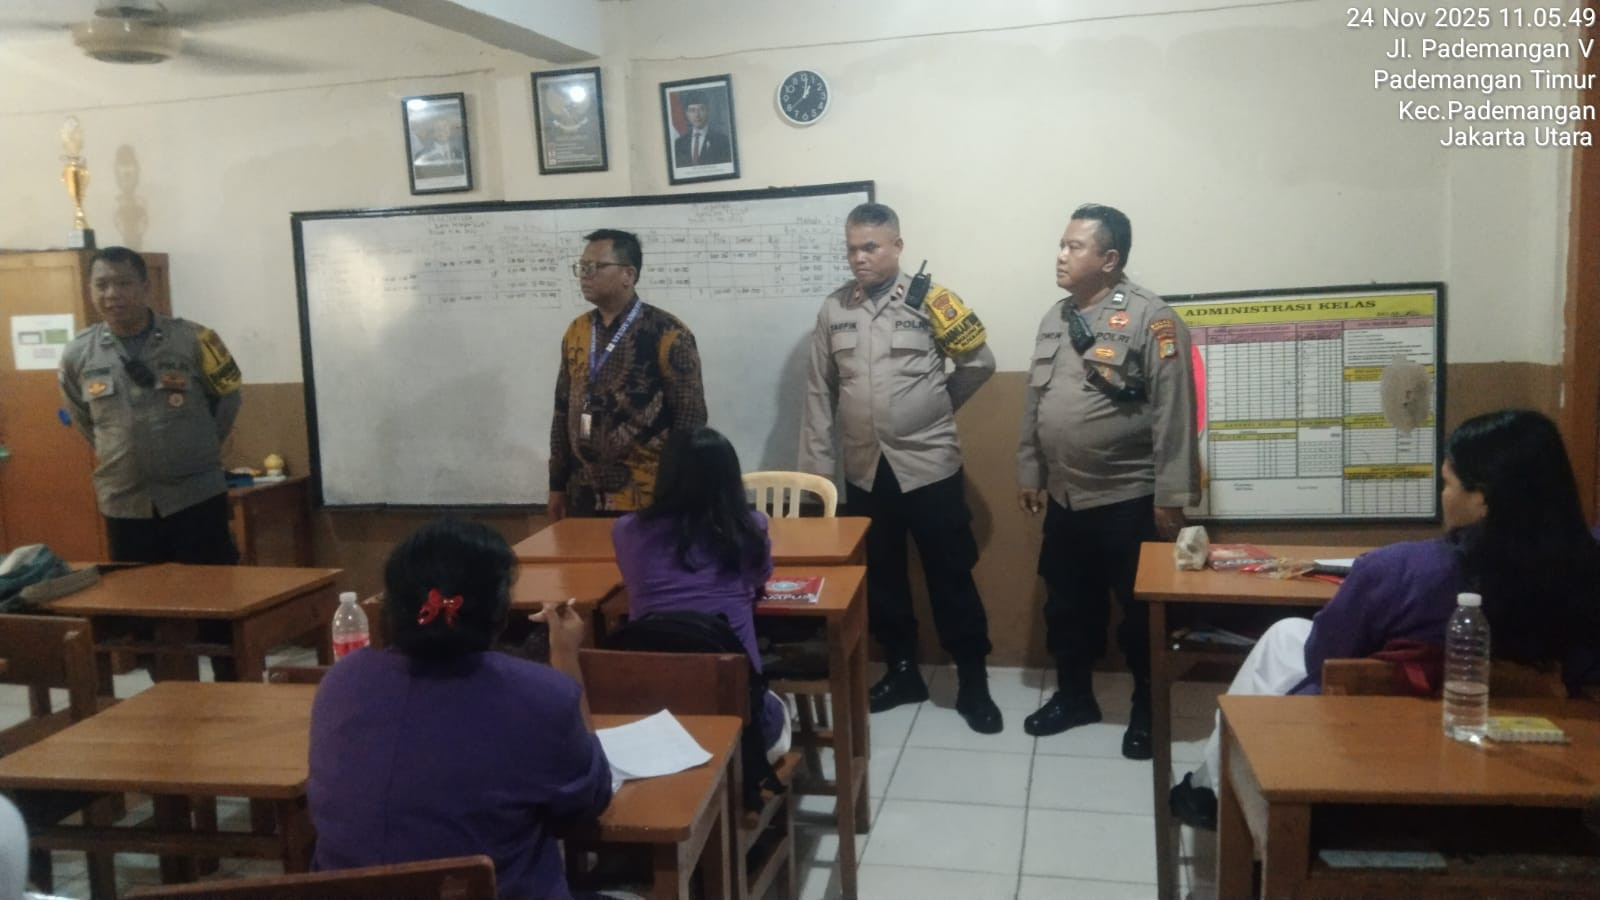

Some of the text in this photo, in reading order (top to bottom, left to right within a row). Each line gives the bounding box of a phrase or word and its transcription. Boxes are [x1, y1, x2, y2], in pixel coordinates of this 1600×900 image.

[1185, 300, 1377, 317] ADMINISTRASI KELAS
[1096, 331, 1131, 343] POLRI
